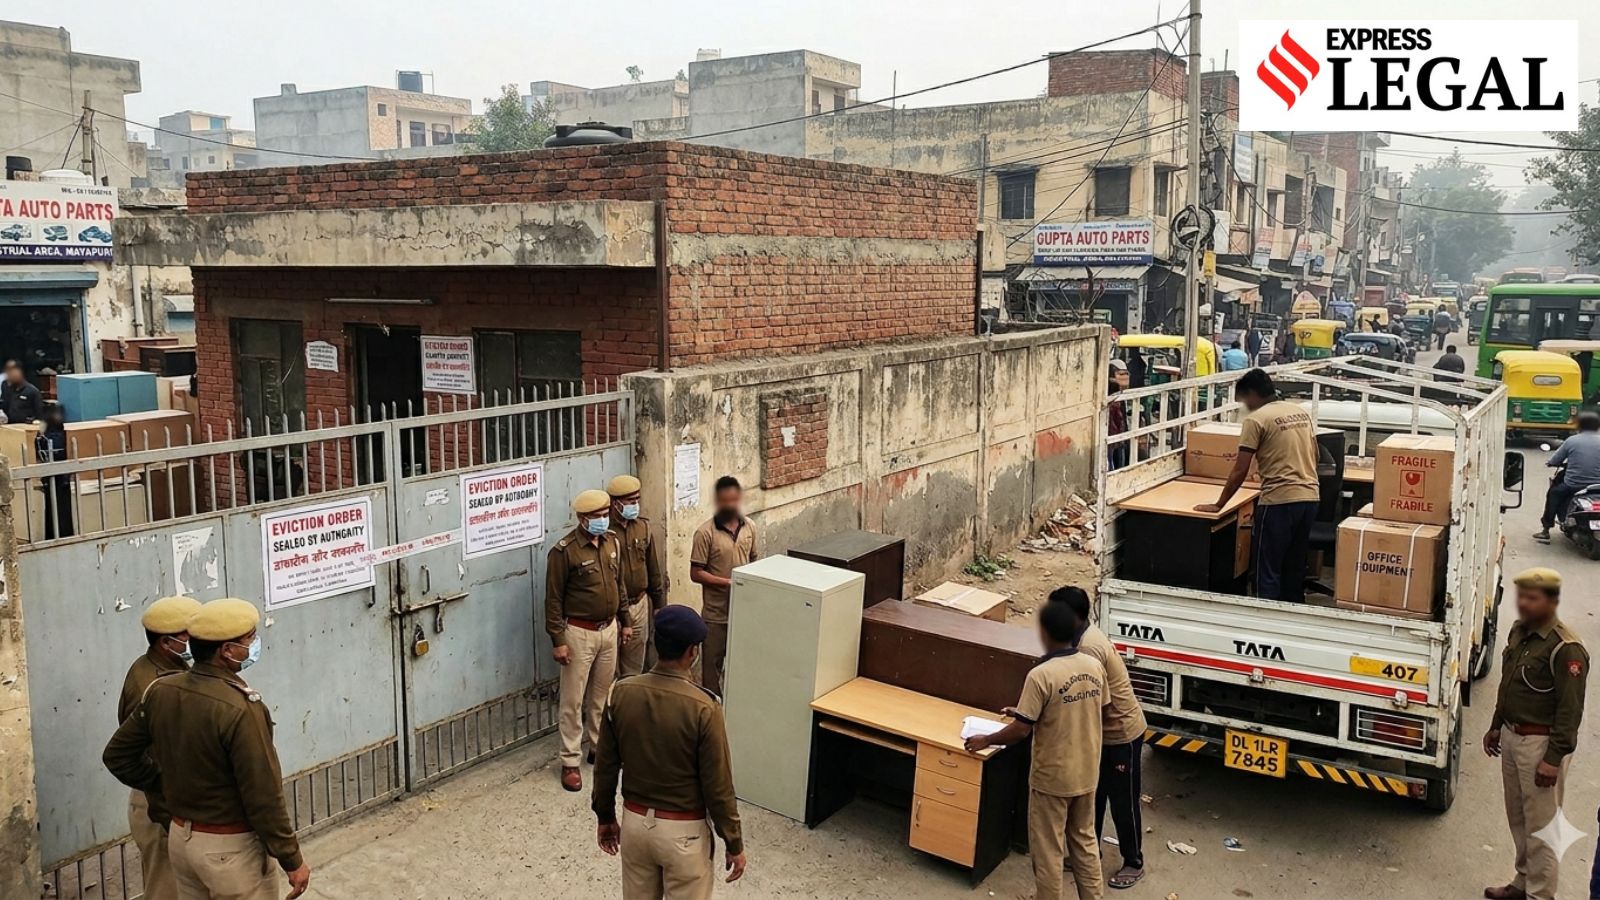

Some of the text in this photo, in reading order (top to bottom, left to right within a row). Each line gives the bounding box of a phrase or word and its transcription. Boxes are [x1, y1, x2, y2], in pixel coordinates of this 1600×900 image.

[19, 200, 60, 219] AUTO
[66, 202, 114, 220] PARTS
[1037, 230, 1150, 245] GUPTA AUTO PARTS
[1391, 455, 1437, 468] FRAGILE
[467, 472, 537, 495] EVICTION ORDER
[272, 515, 325, 537] EVICTION
[1117, 623, 1165, 642] TATA
[1232, 640, 1286, 661] TATA
[1381, 664, 1418, 681] 407
[1232, 735, 1278, 756] DL 1LR
[1232, 750, 1278, 772] 7845
